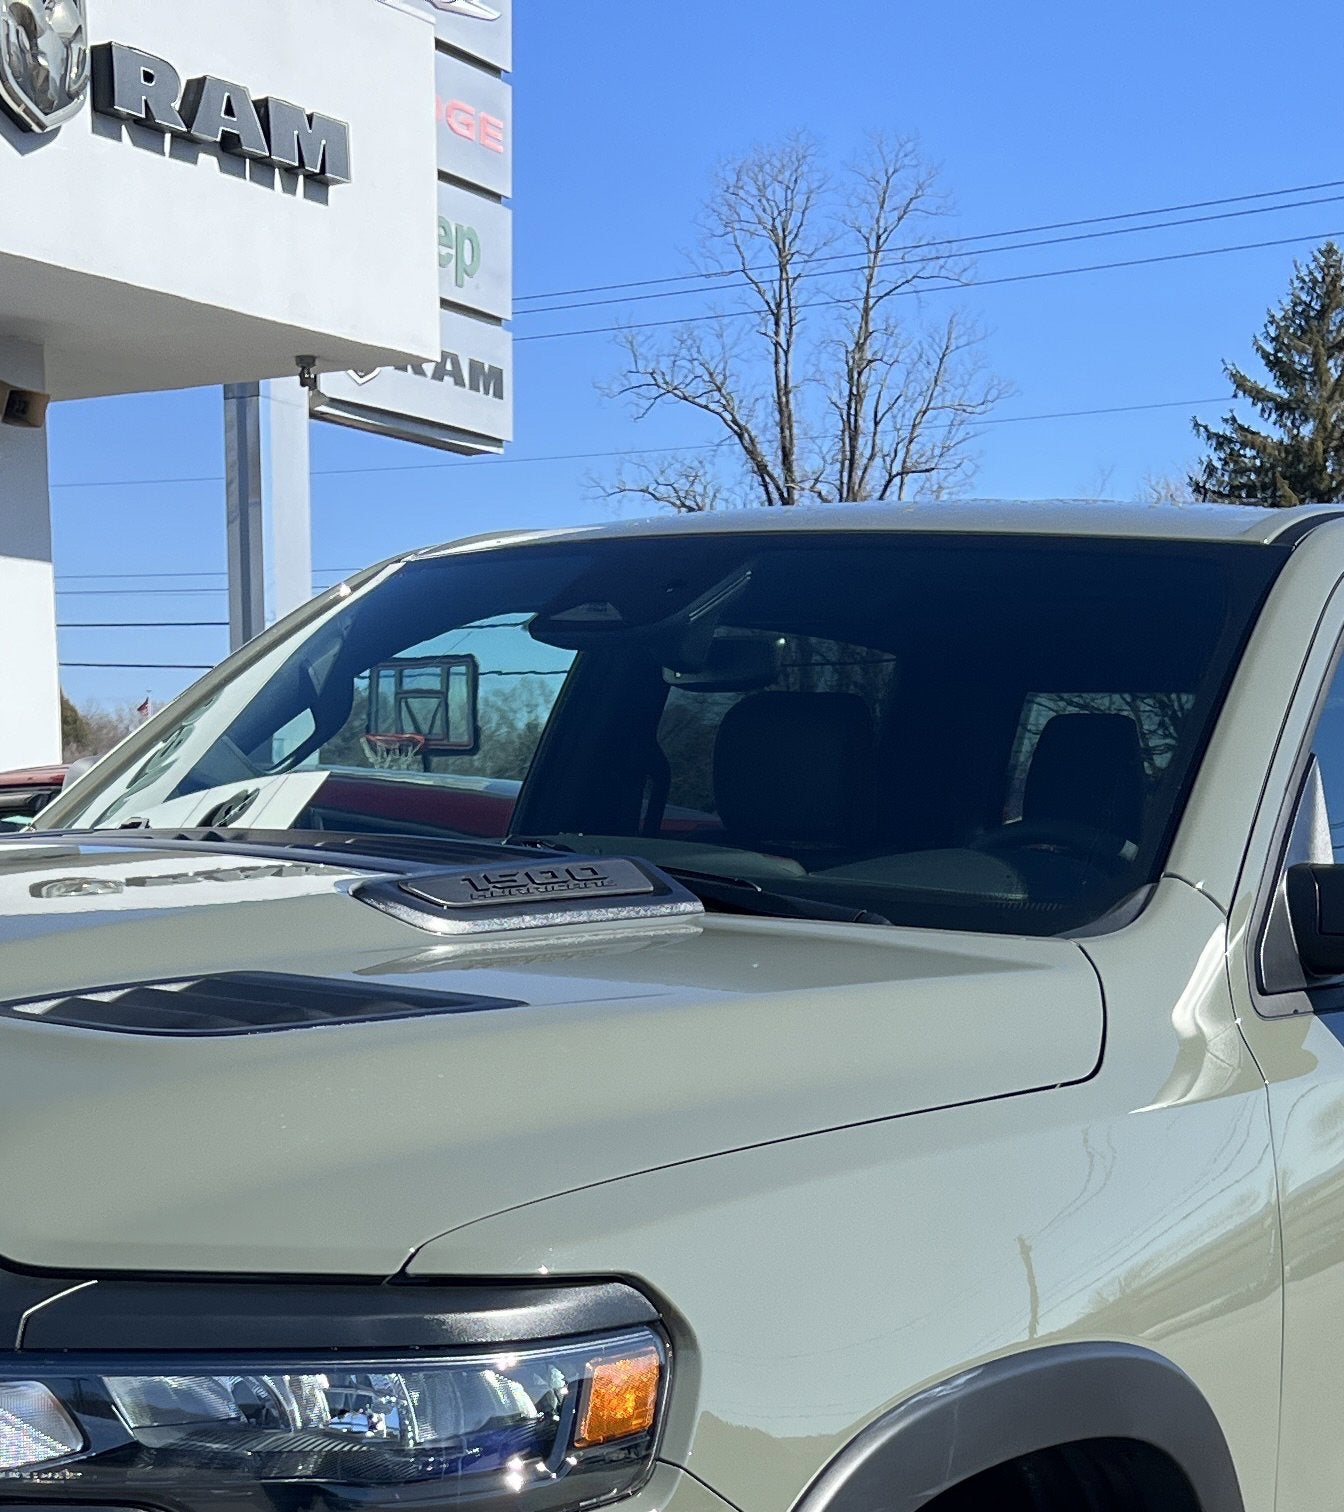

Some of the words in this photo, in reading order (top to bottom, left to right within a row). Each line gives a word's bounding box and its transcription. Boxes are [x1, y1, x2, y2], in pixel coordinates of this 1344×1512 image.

[92, 41, 352, 186] RAM
[435, 95, 504, 153] GE
[461, 867, 609, 892] 1500
